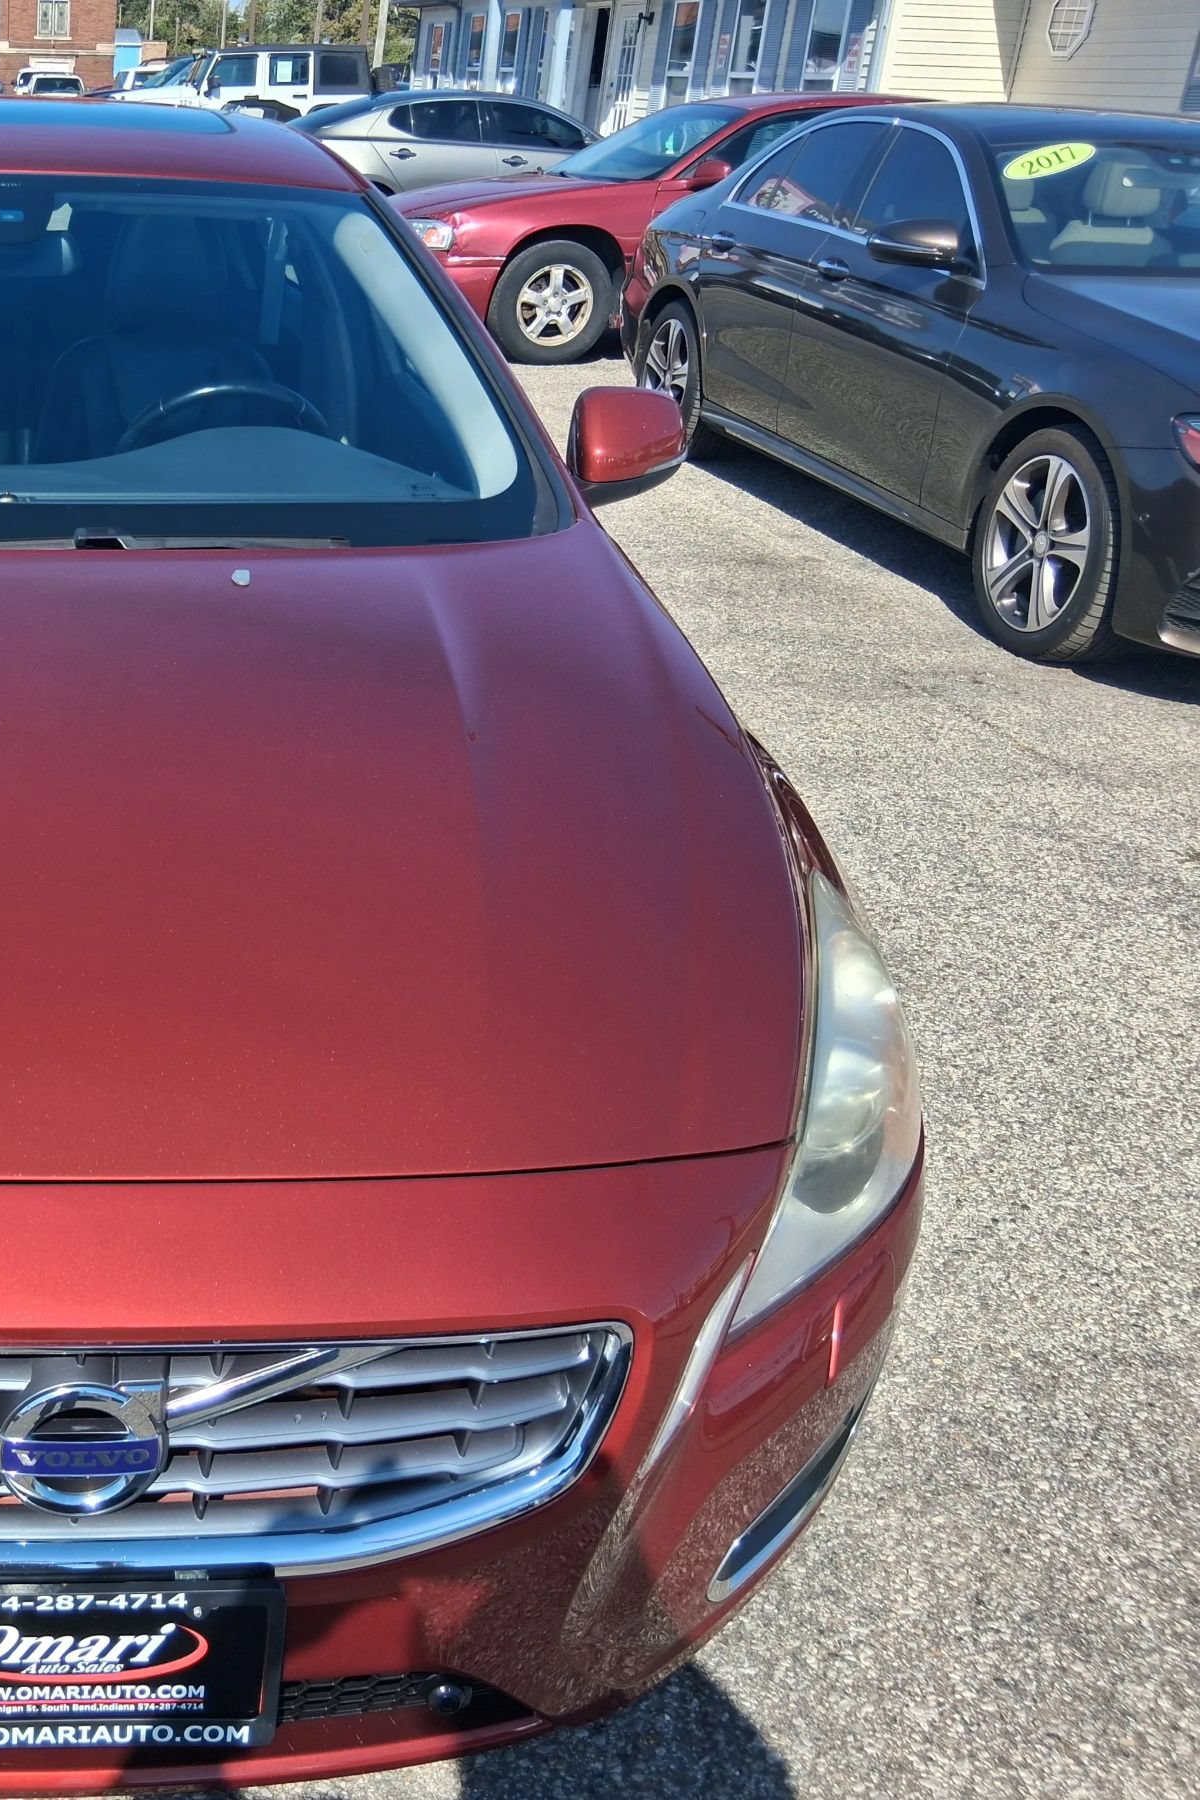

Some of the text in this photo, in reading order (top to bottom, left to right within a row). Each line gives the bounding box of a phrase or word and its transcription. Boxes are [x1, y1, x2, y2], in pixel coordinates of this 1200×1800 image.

[1021, 145, 1076, 175] 2017
[11, 1448, 150, 1468] VOLVO
[21, 1661, 124, 1674] Auto Sales
[26, 1704, 39, 1713] St.
[41, 1703, 70, 1712] South
[137, 1702, 204, 1712] 574-287-4714
